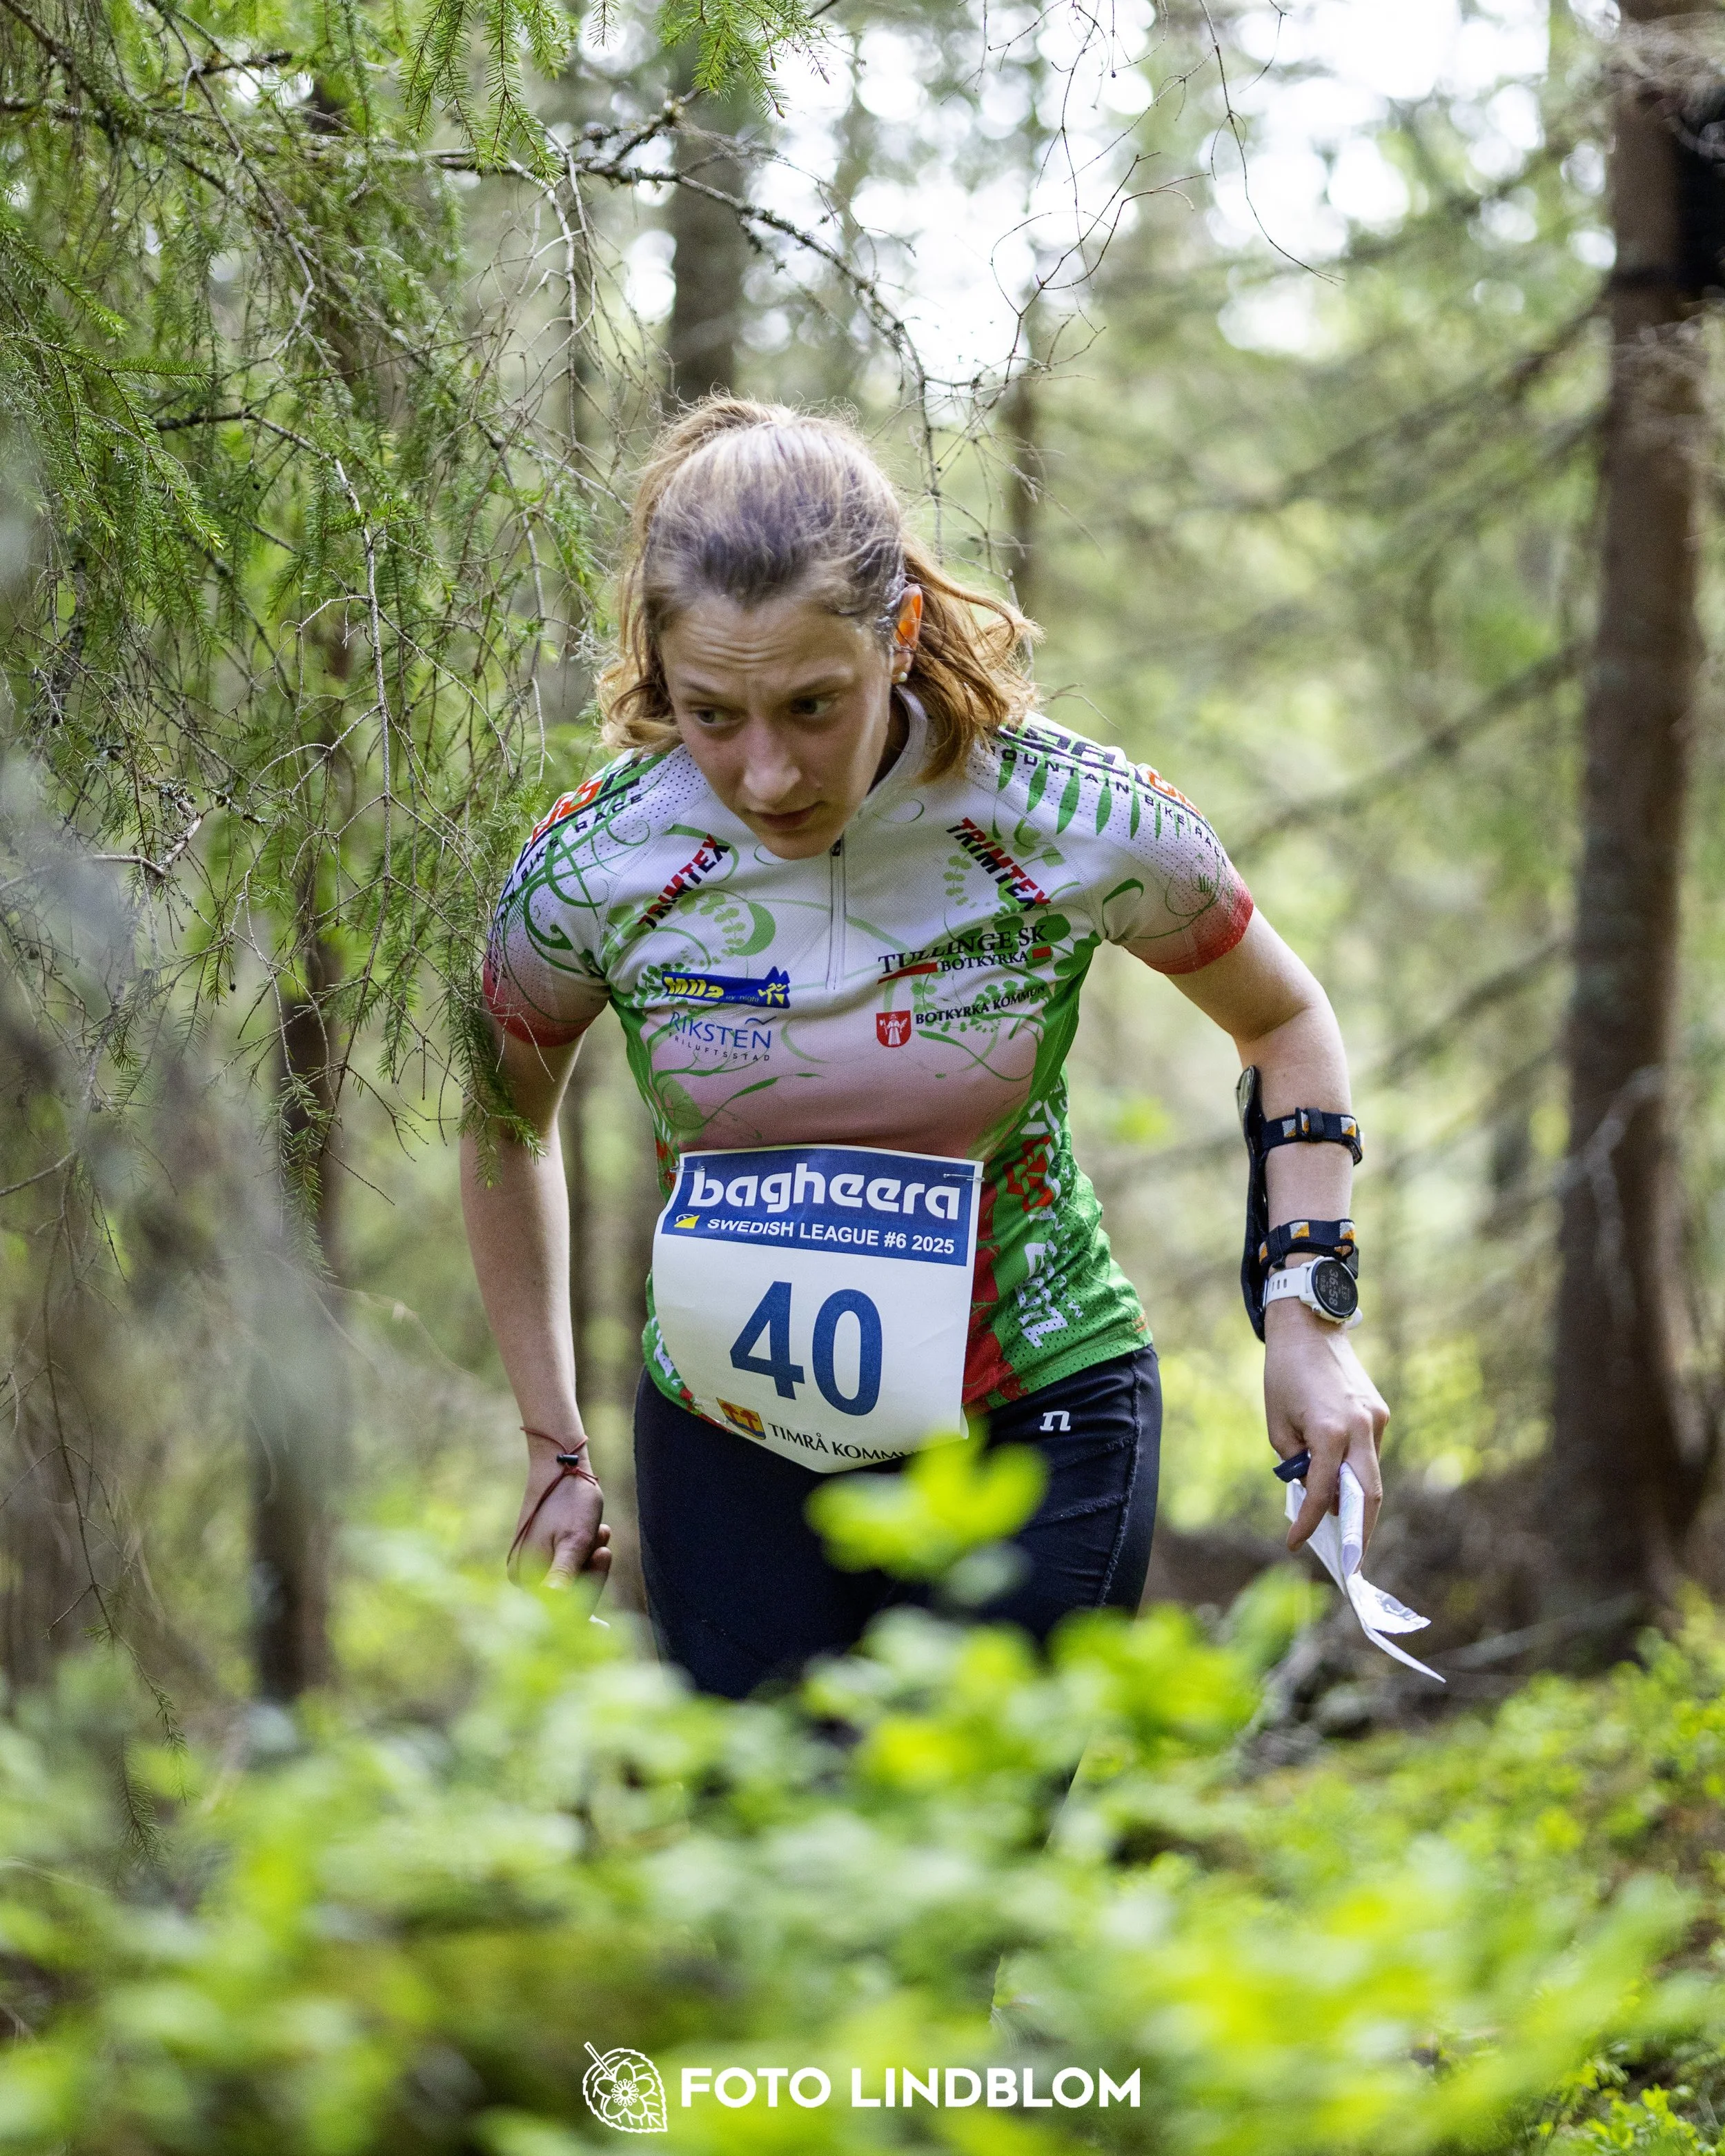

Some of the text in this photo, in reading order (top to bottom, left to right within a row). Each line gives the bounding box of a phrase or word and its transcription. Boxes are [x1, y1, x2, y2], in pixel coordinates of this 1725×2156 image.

[1144, 794, 1185, 826] BIKE
[520, 835, 560, 882] BIKE
[574, 793, 644, 833] RACE
[637, 833, 731, 930] TRIMTEX
[946, 817, 1052, 911] TRIMTEX
[878, 924, 1048, 974] TULLINGE SK
[940, 951, 1029, 972] BOTKYRKA
[916, 985, 1045, 1025] BOTKYRKA KOMMUN
[669, 1011, 771, 1049] RIKSTEN
[669, 1032, 770, 1061] FRILUFTSSTAD
[688, 1163, 960, 1220] bagheera
[707, 1218, 956, 1255] SWEDISH LEAGUE #6 2025
[729, 1280, 883, 1416] 40
[768, 1423, 829, 1454] TIMRÅ
